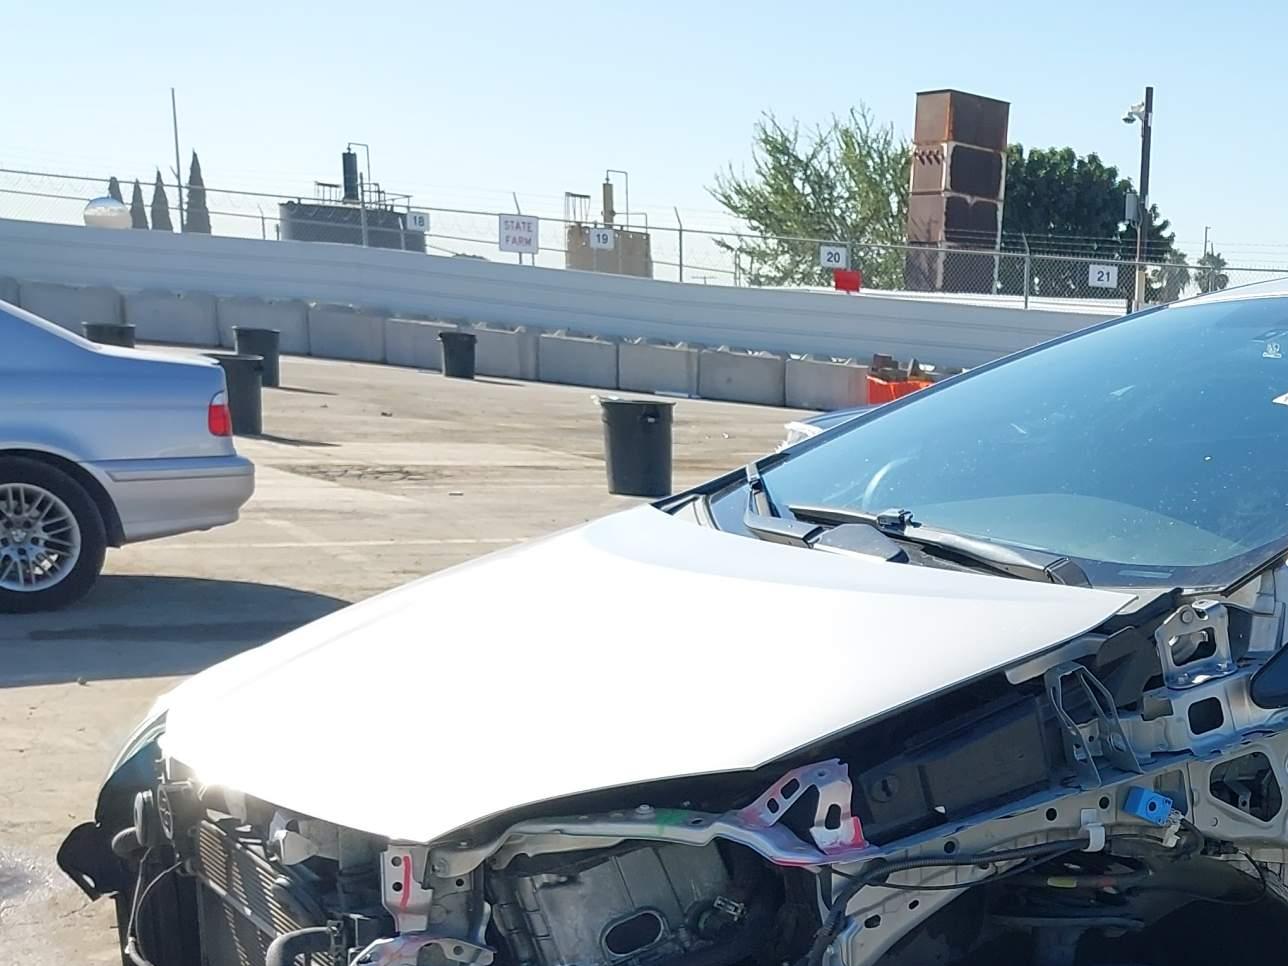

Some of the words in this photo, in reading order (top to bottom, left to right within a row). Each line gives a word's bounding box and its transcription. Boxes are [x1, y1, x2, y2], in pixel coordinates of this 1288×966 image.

[413, 216, 425, 227] 18
[504, 220, 533, 233] STATE
[505, 235, 531, 247] FARM
[596, 233, 608, 244] 19
[827, 251, 840, 263] 20
[1098, 271, 1110, 282] 21
